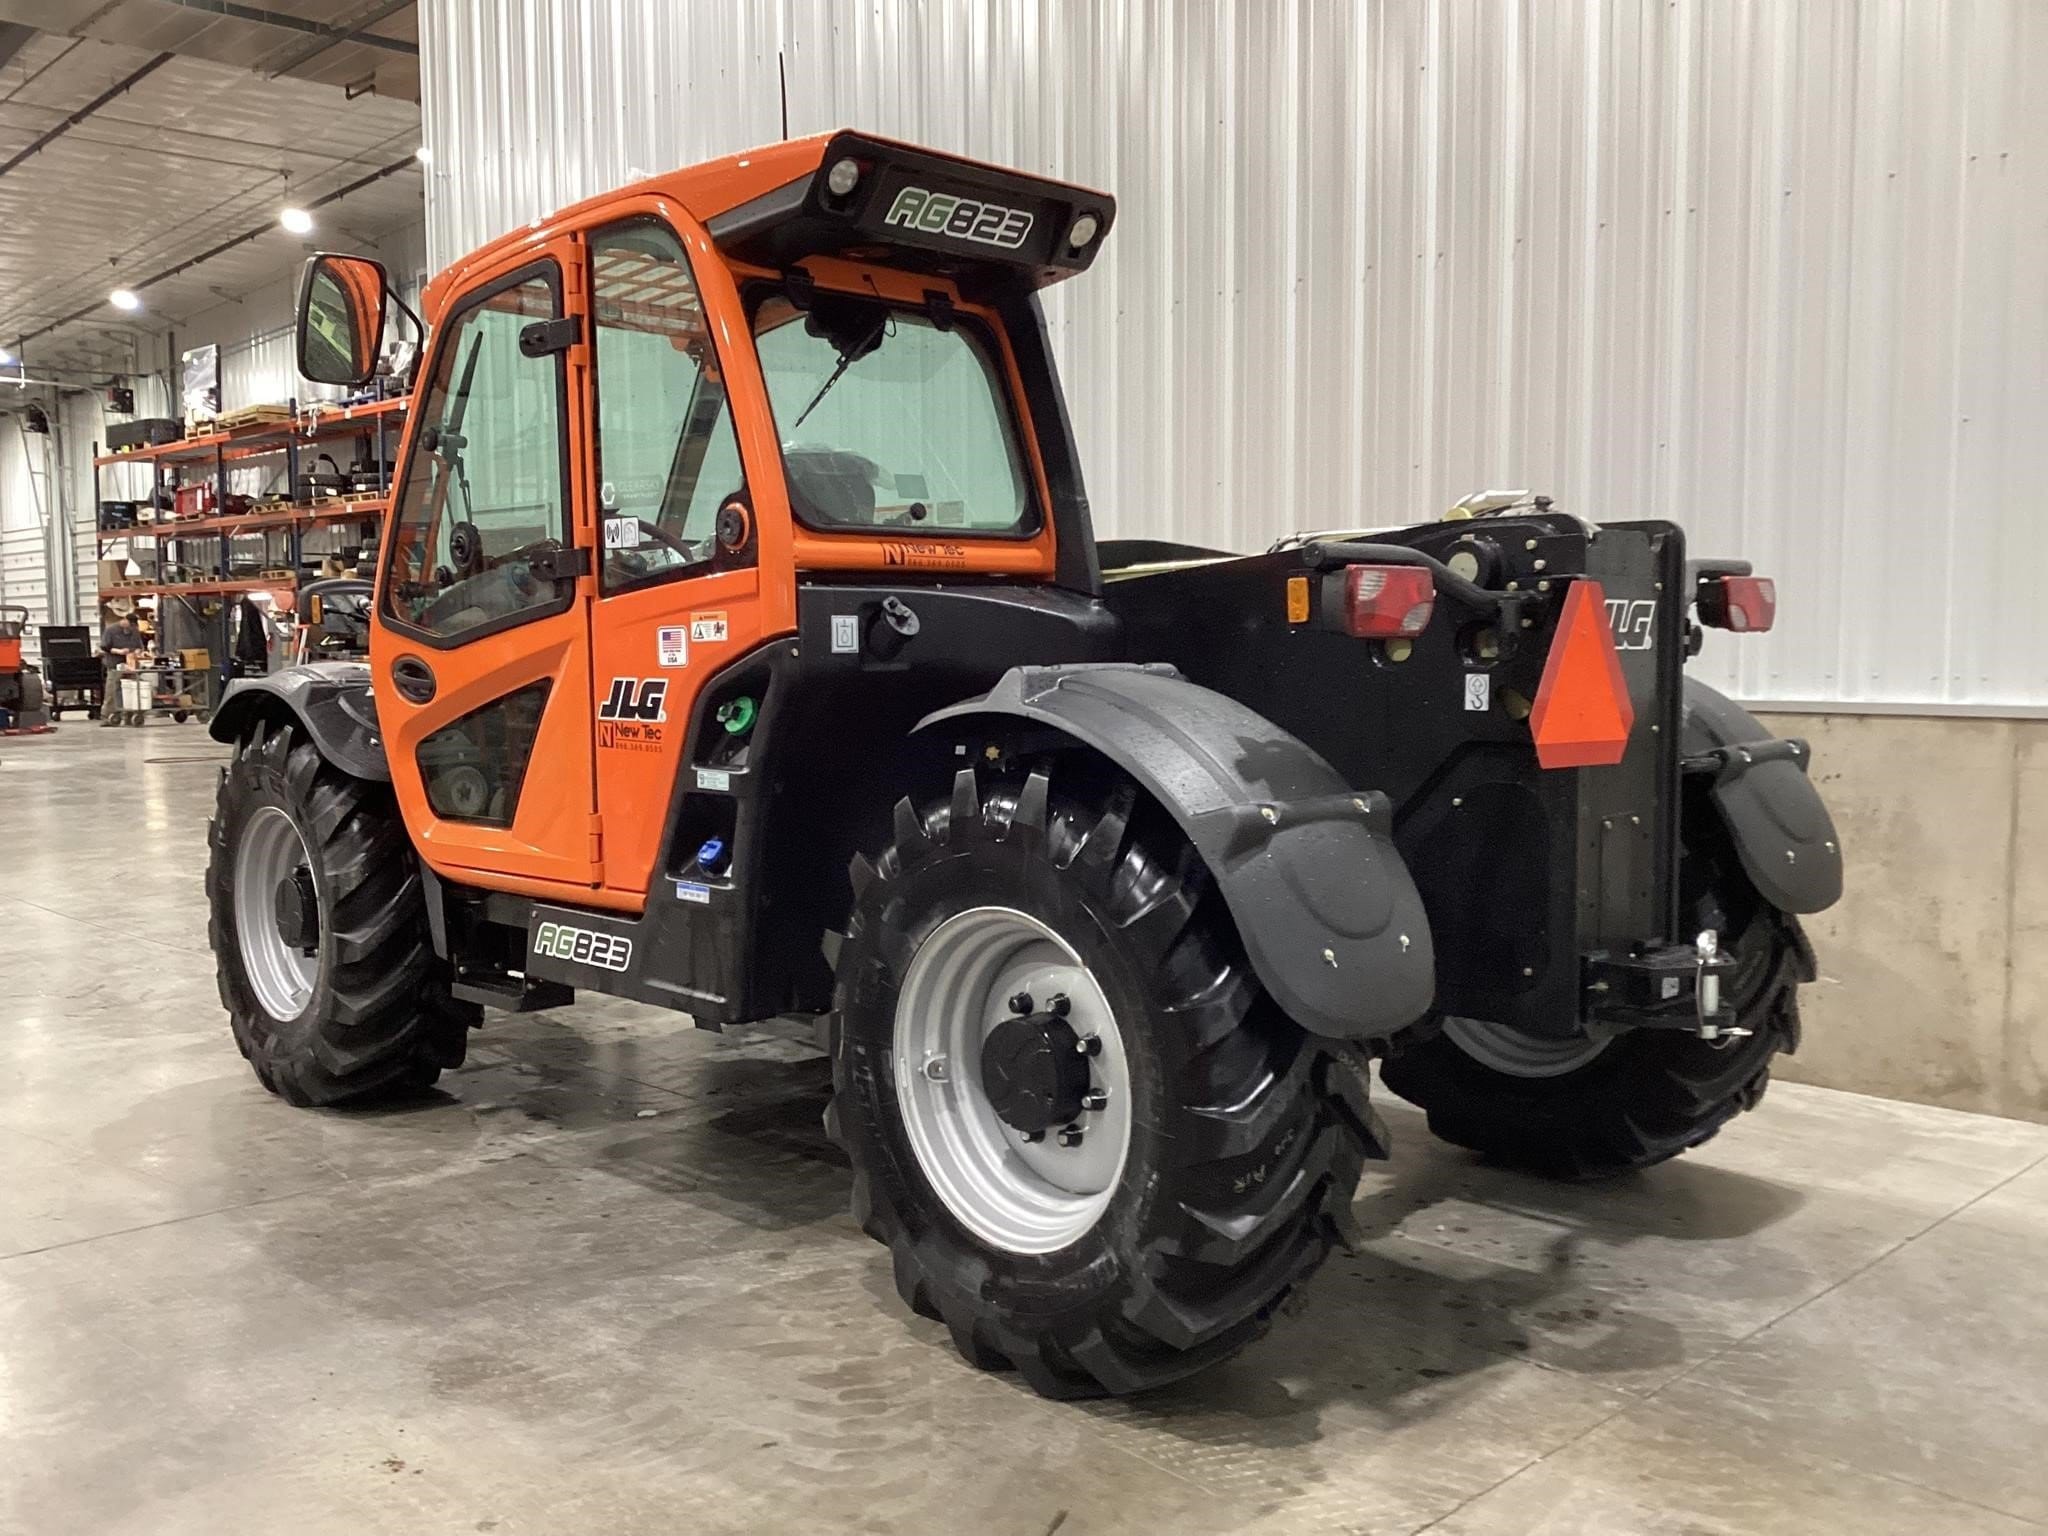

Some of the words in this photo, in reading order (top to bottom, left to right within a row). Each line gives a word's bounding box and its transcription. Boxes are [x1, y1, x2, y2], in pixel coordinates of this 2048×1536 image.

[885, 186, 1033, 248] AG823
[599, 677, 668, 721] JLG
[615, 722, 640, 738] New
[641, 724, 662, 740] Tec
[534, 922, 632, 972] AG823
